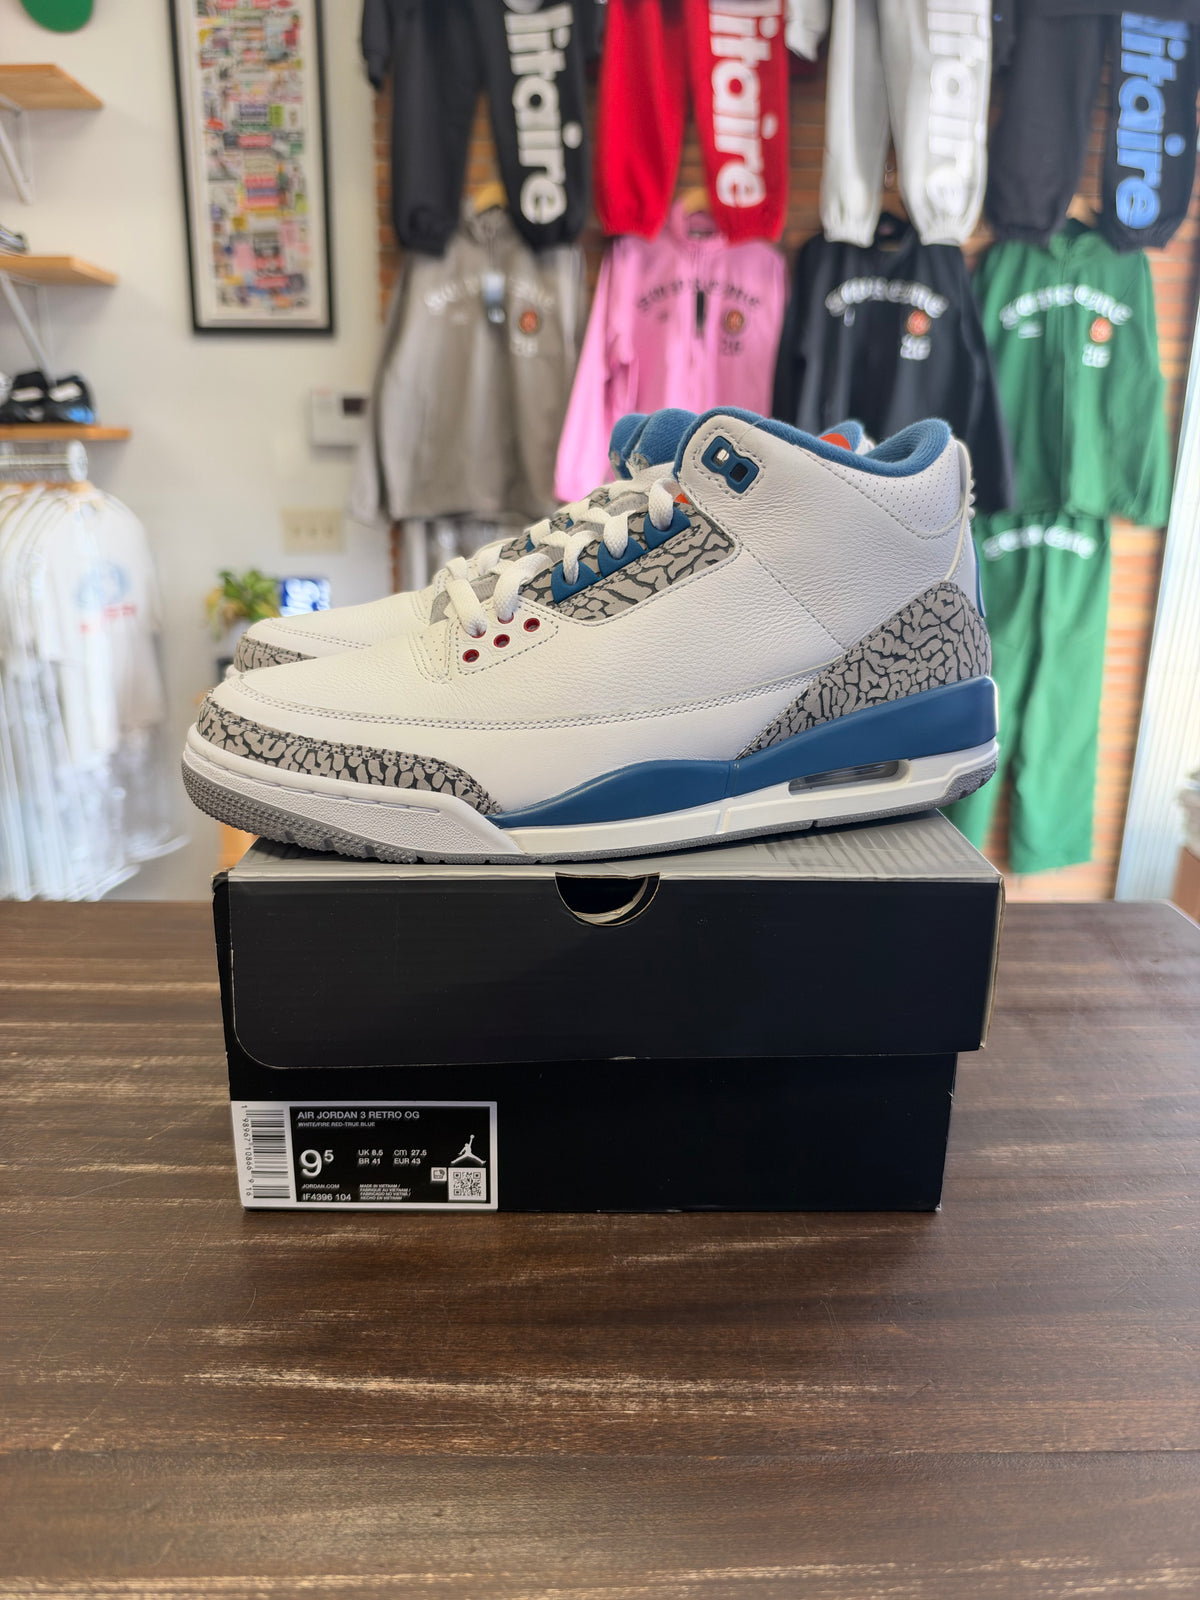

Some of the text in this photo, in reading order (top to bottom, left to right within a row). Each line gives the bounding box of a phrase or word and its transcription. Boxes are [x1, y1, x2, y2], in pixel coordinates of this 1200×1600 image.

[297, 1111, 420, 1120] AIR JORDAN 3 RETRO OG
[242, 1118, 250, 1142] 98967
[358, 1149, 384, 1157] UK 8.5
[411, 1149, 428, 1157] 27.5
[358, 1157, 381, 1165] BR 41
[394, 1157, 421, 1165] EUR 43
[302, 1193, 352, 1202] IF4396 104
